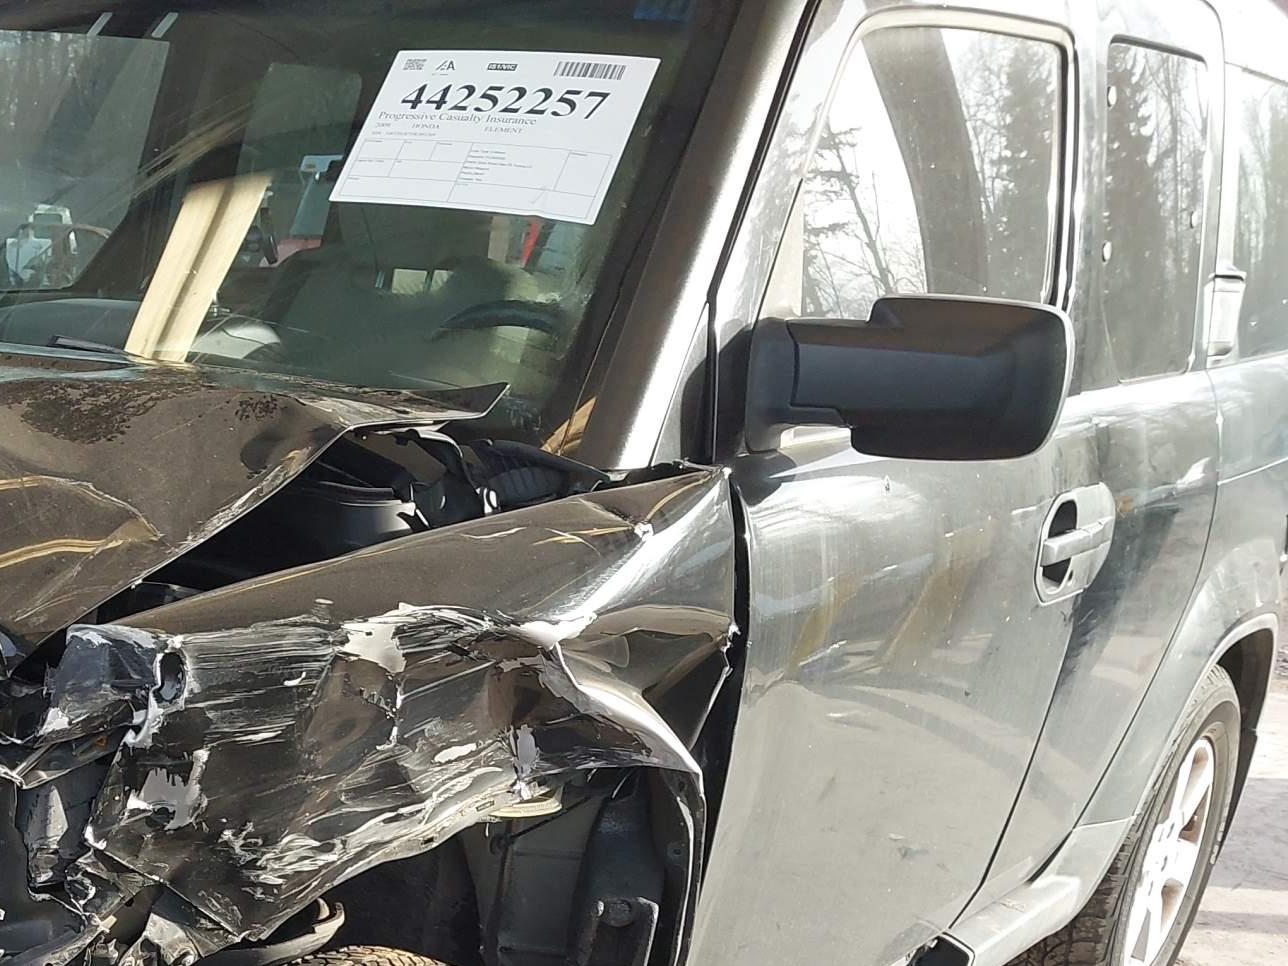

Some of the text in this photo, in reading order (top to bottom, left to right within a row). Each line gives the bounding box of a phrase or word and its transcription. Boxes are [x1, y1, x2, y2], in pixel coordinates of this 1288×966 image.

[400, 83, 611, 120] 44252257
[378, 111, 537, 126] Progressive Casualty Insurance
